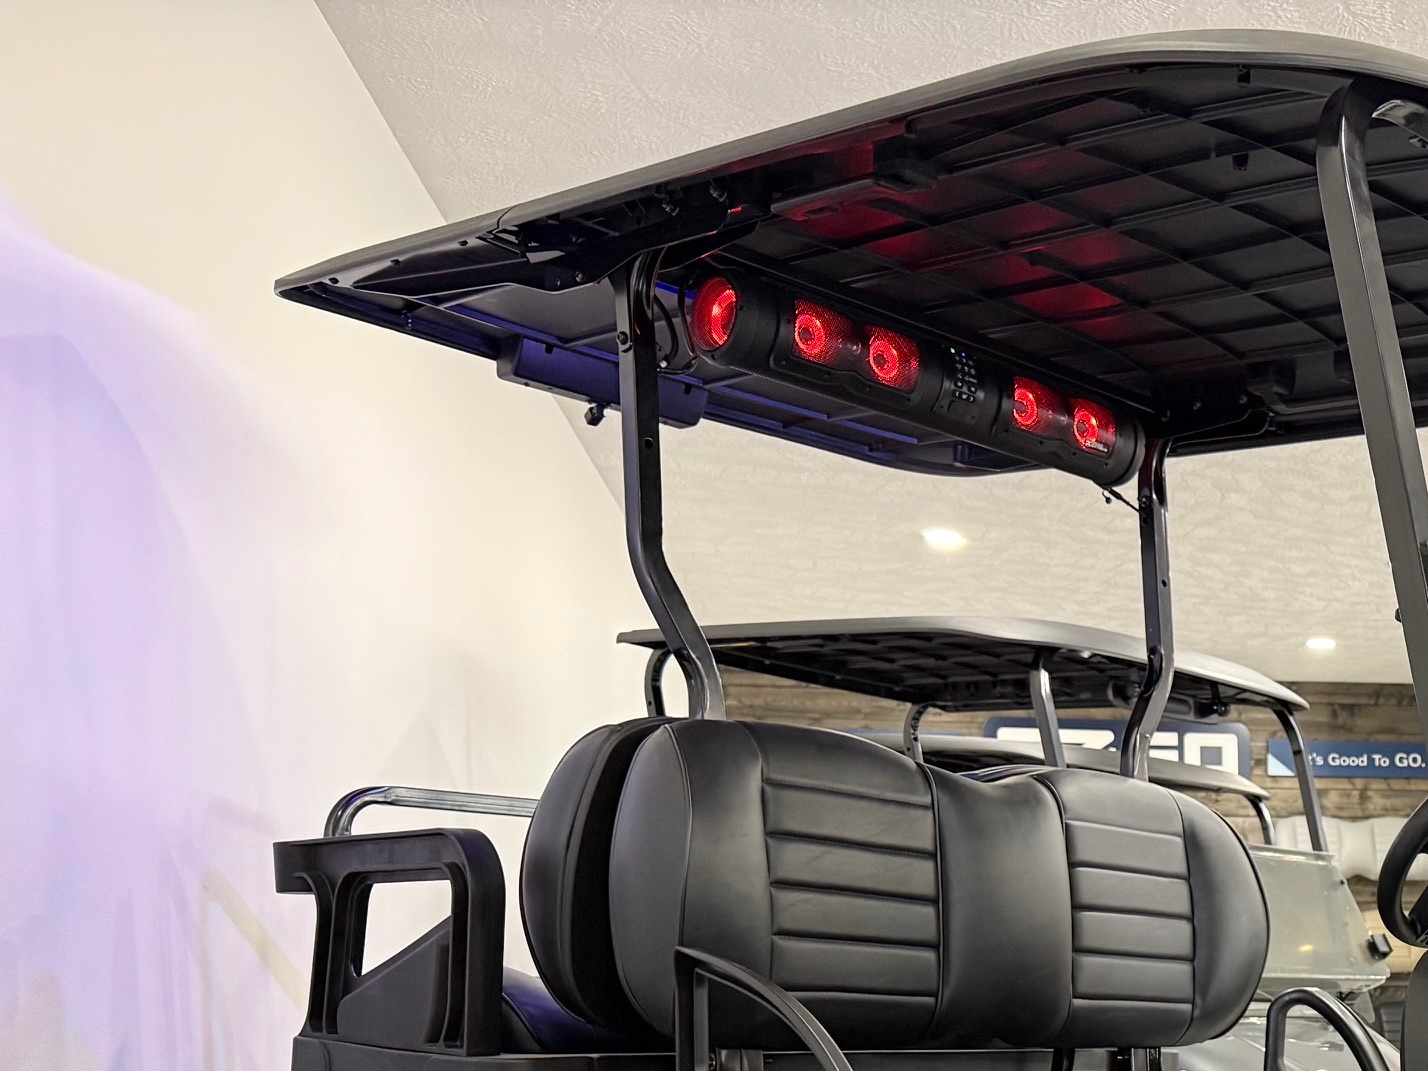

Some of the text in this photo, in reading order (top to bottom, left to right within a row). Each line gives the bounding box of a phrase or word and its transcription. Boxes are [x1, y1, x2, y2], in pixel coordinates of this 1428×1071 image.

[1307, 752, 1426, 768] t's Good To GO.
